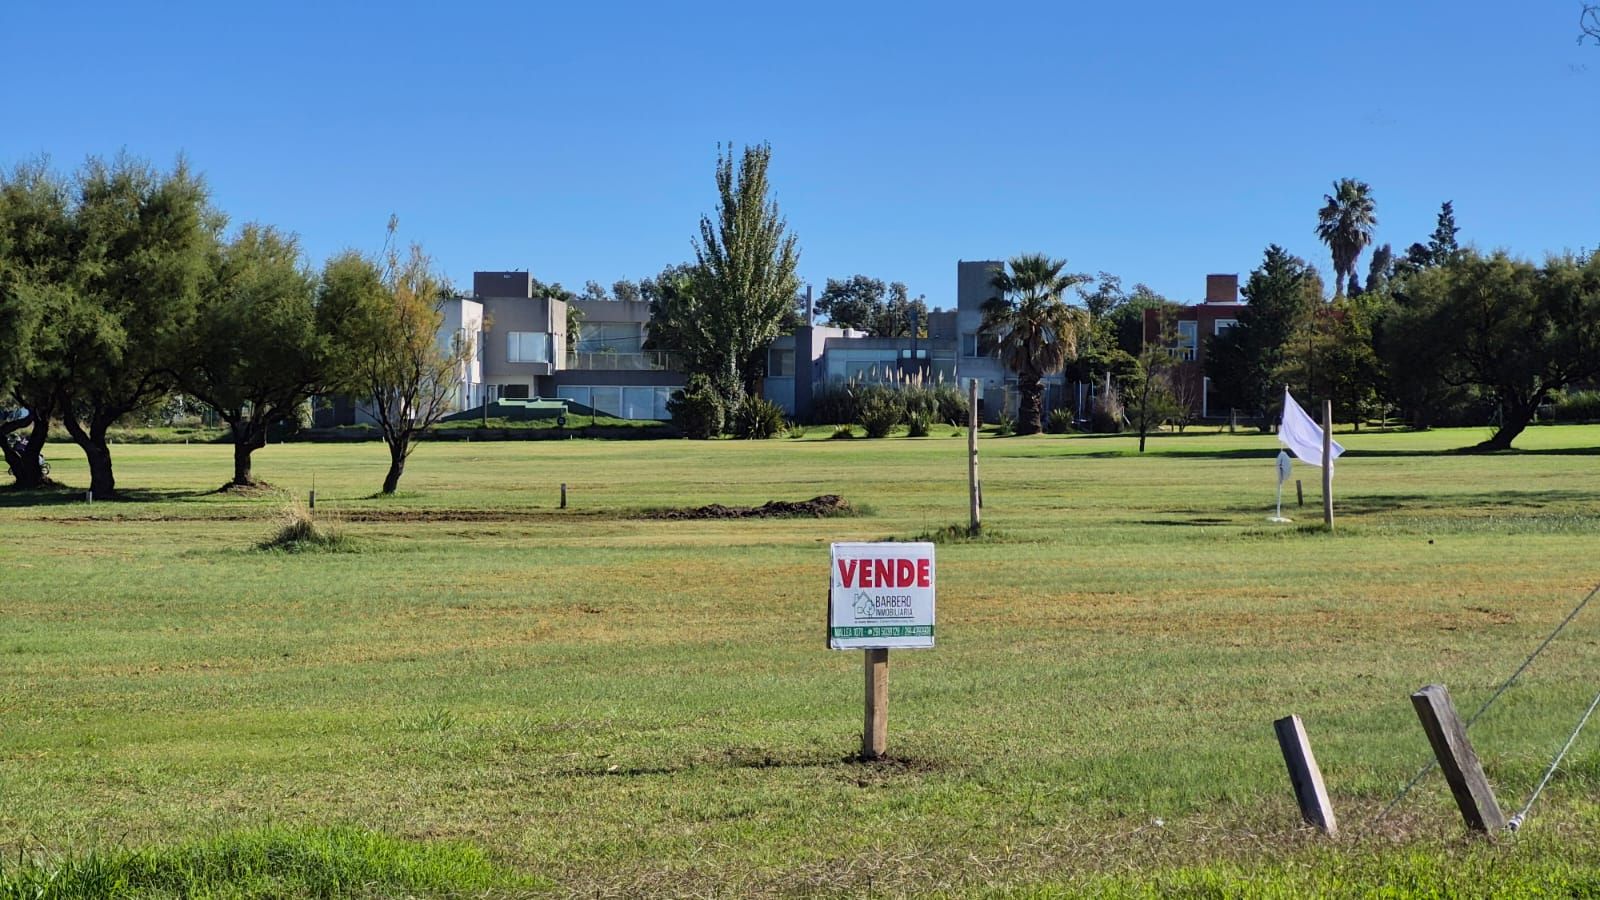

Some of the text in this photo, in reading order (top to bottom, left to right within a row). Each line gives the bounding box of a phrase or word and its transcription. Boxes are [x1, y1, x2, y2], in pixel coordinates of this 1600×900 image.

[838, 559, 930, 588] VENDE
[876, 595, 912, 608] BARBERO
[876, 608, 913, 617] INMOBILIARIA
